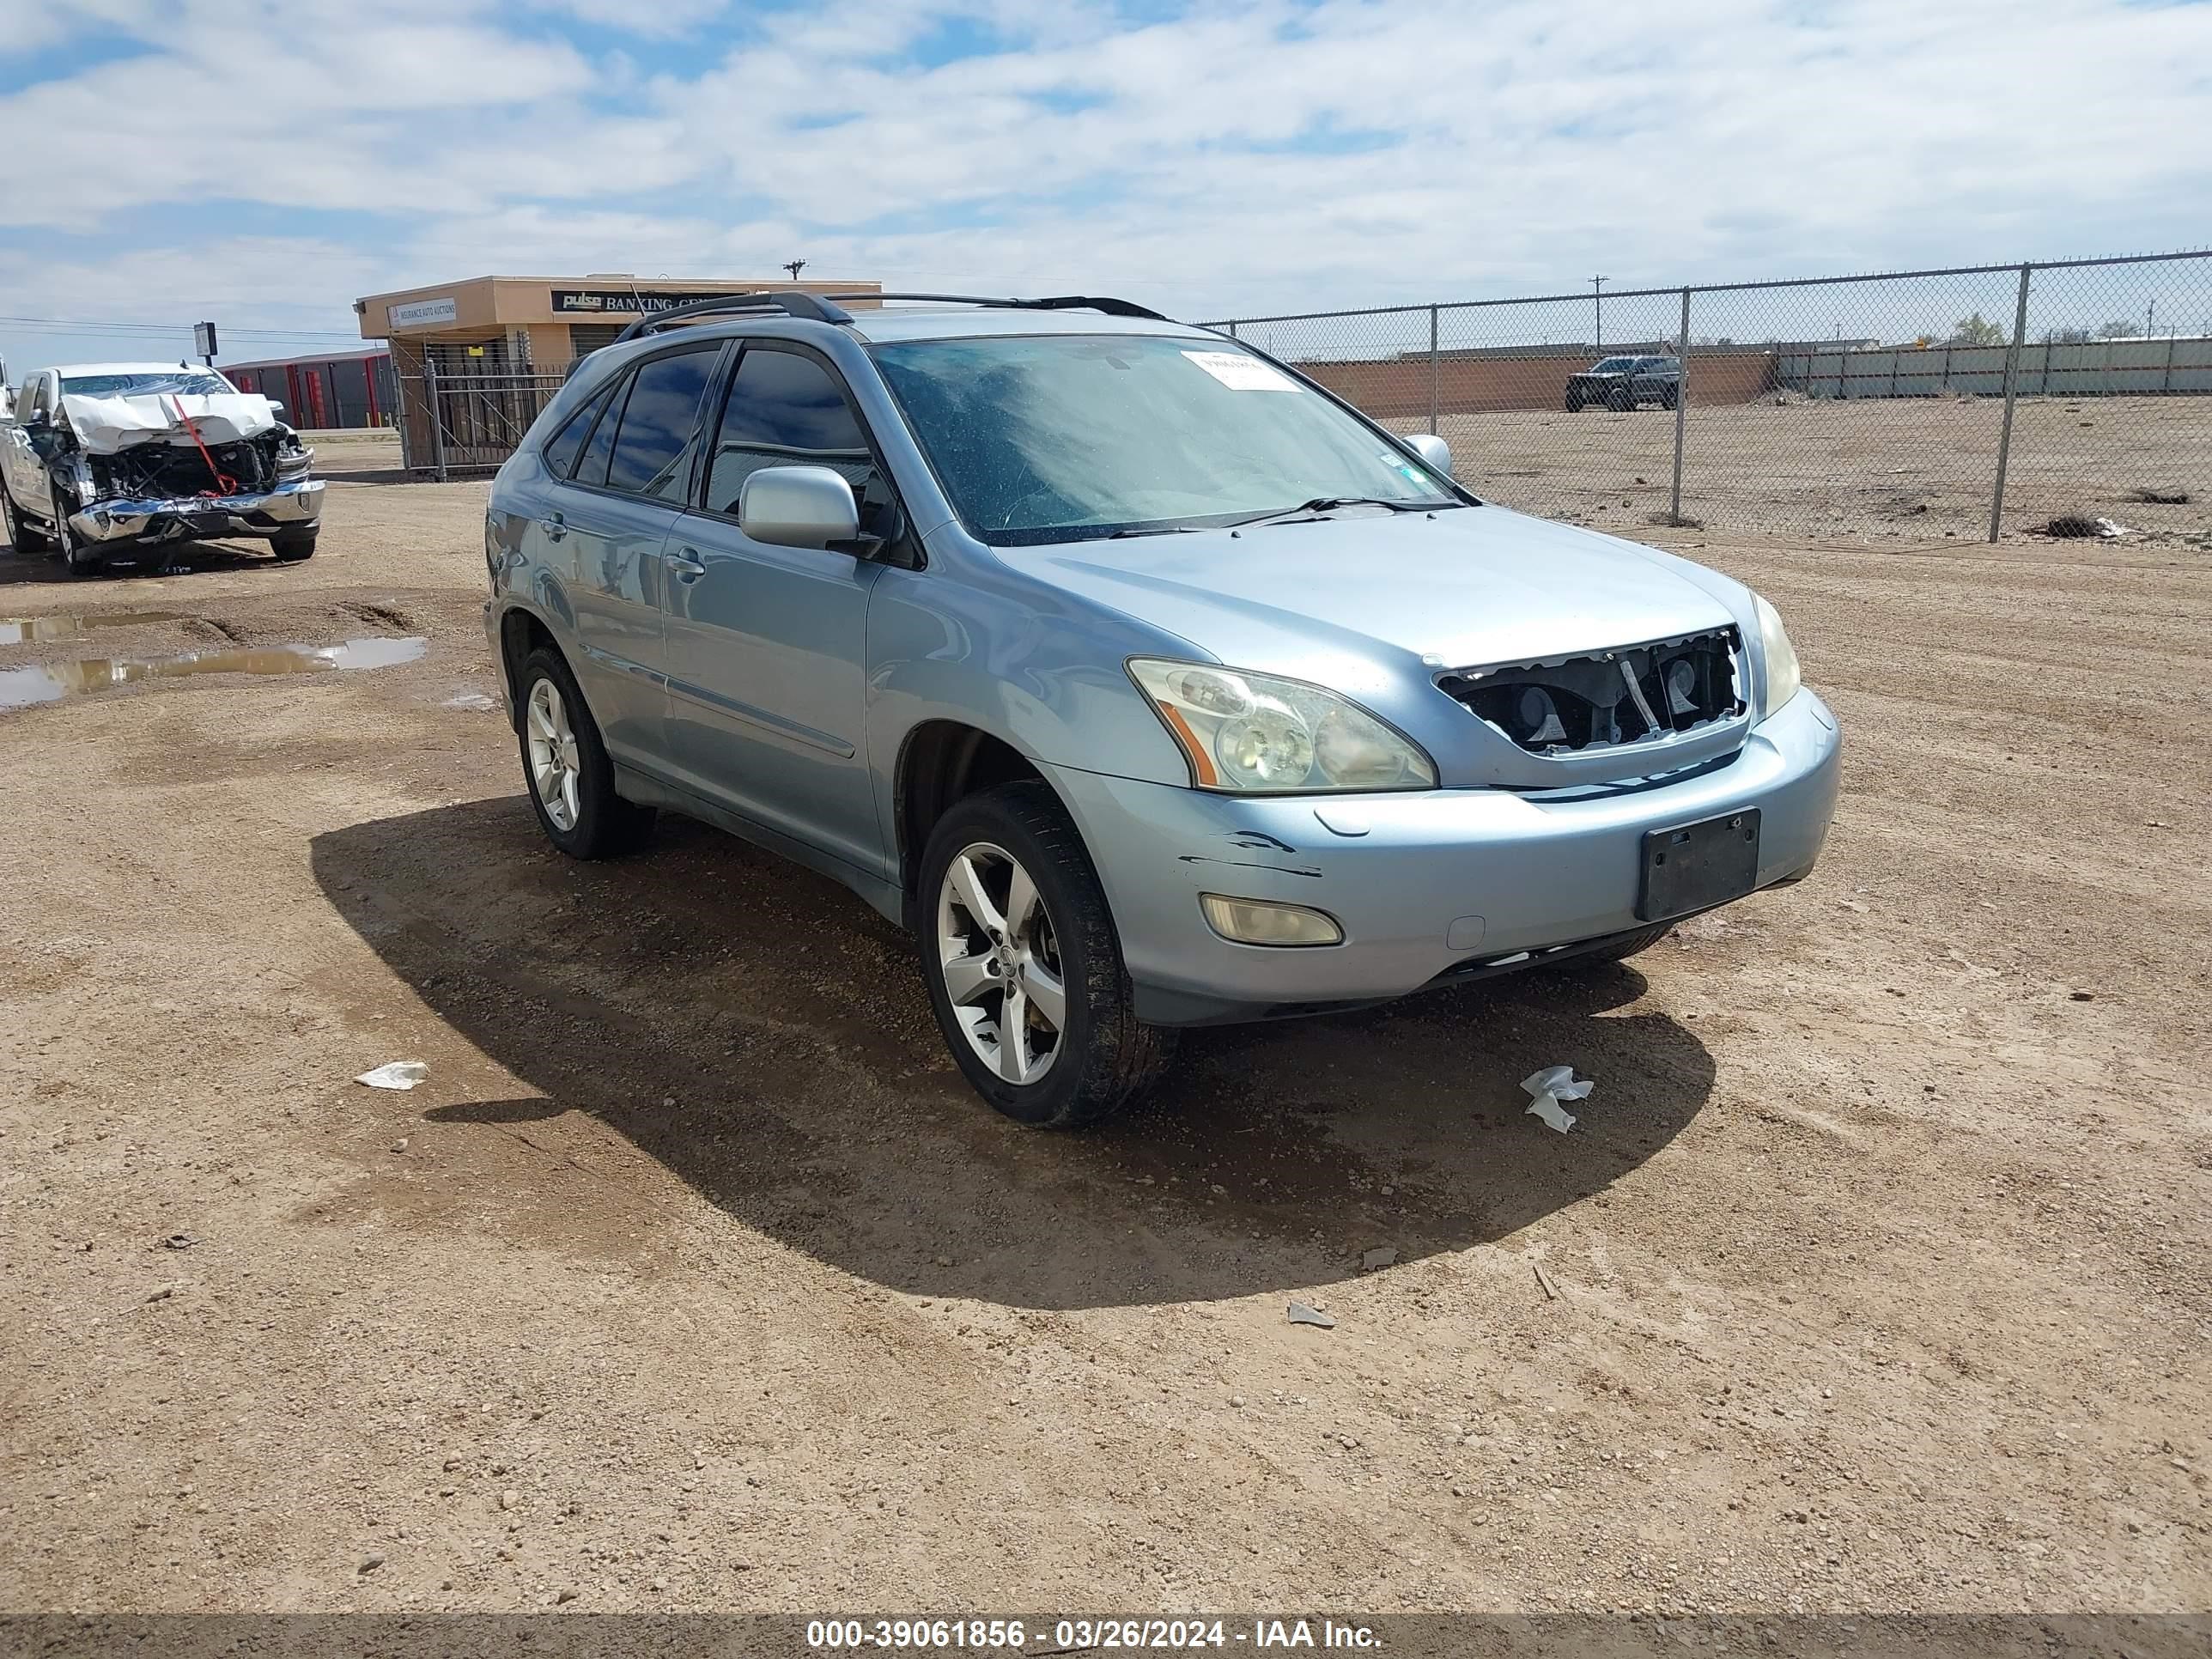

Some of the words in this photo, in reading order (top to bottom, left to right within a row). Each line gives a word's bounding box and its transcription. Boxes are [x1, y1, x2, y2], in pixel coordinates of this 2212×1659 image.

[563, 292, 602, 308] pulse
[606, 298, 673, 311] BANKING
[422, 307, 434, 317] AUTO
[434, 304, 455, 315] AUCTIONS
